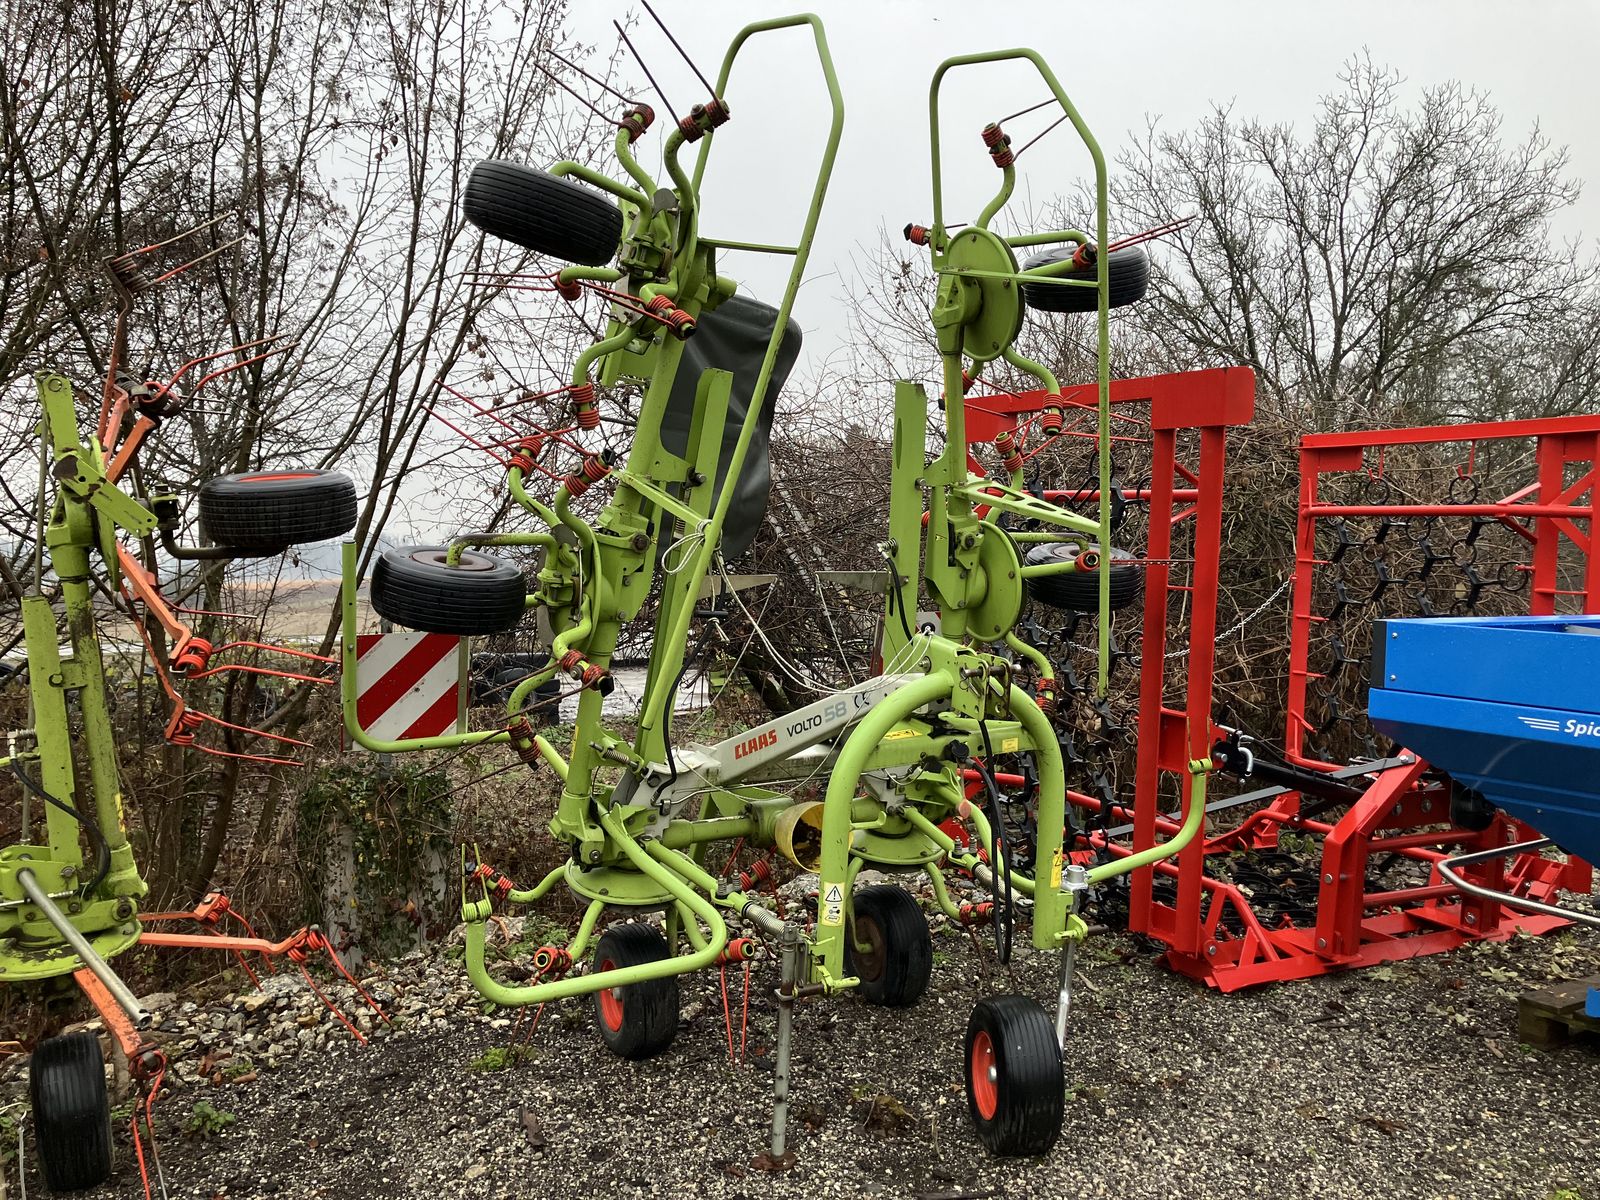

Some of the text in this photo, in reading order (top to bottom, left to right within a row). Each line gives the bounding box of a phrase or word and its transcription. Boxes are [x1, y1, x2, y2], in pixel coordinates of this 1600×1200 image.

[734, 700, 848, 760] CLAAS VOLTO 58
